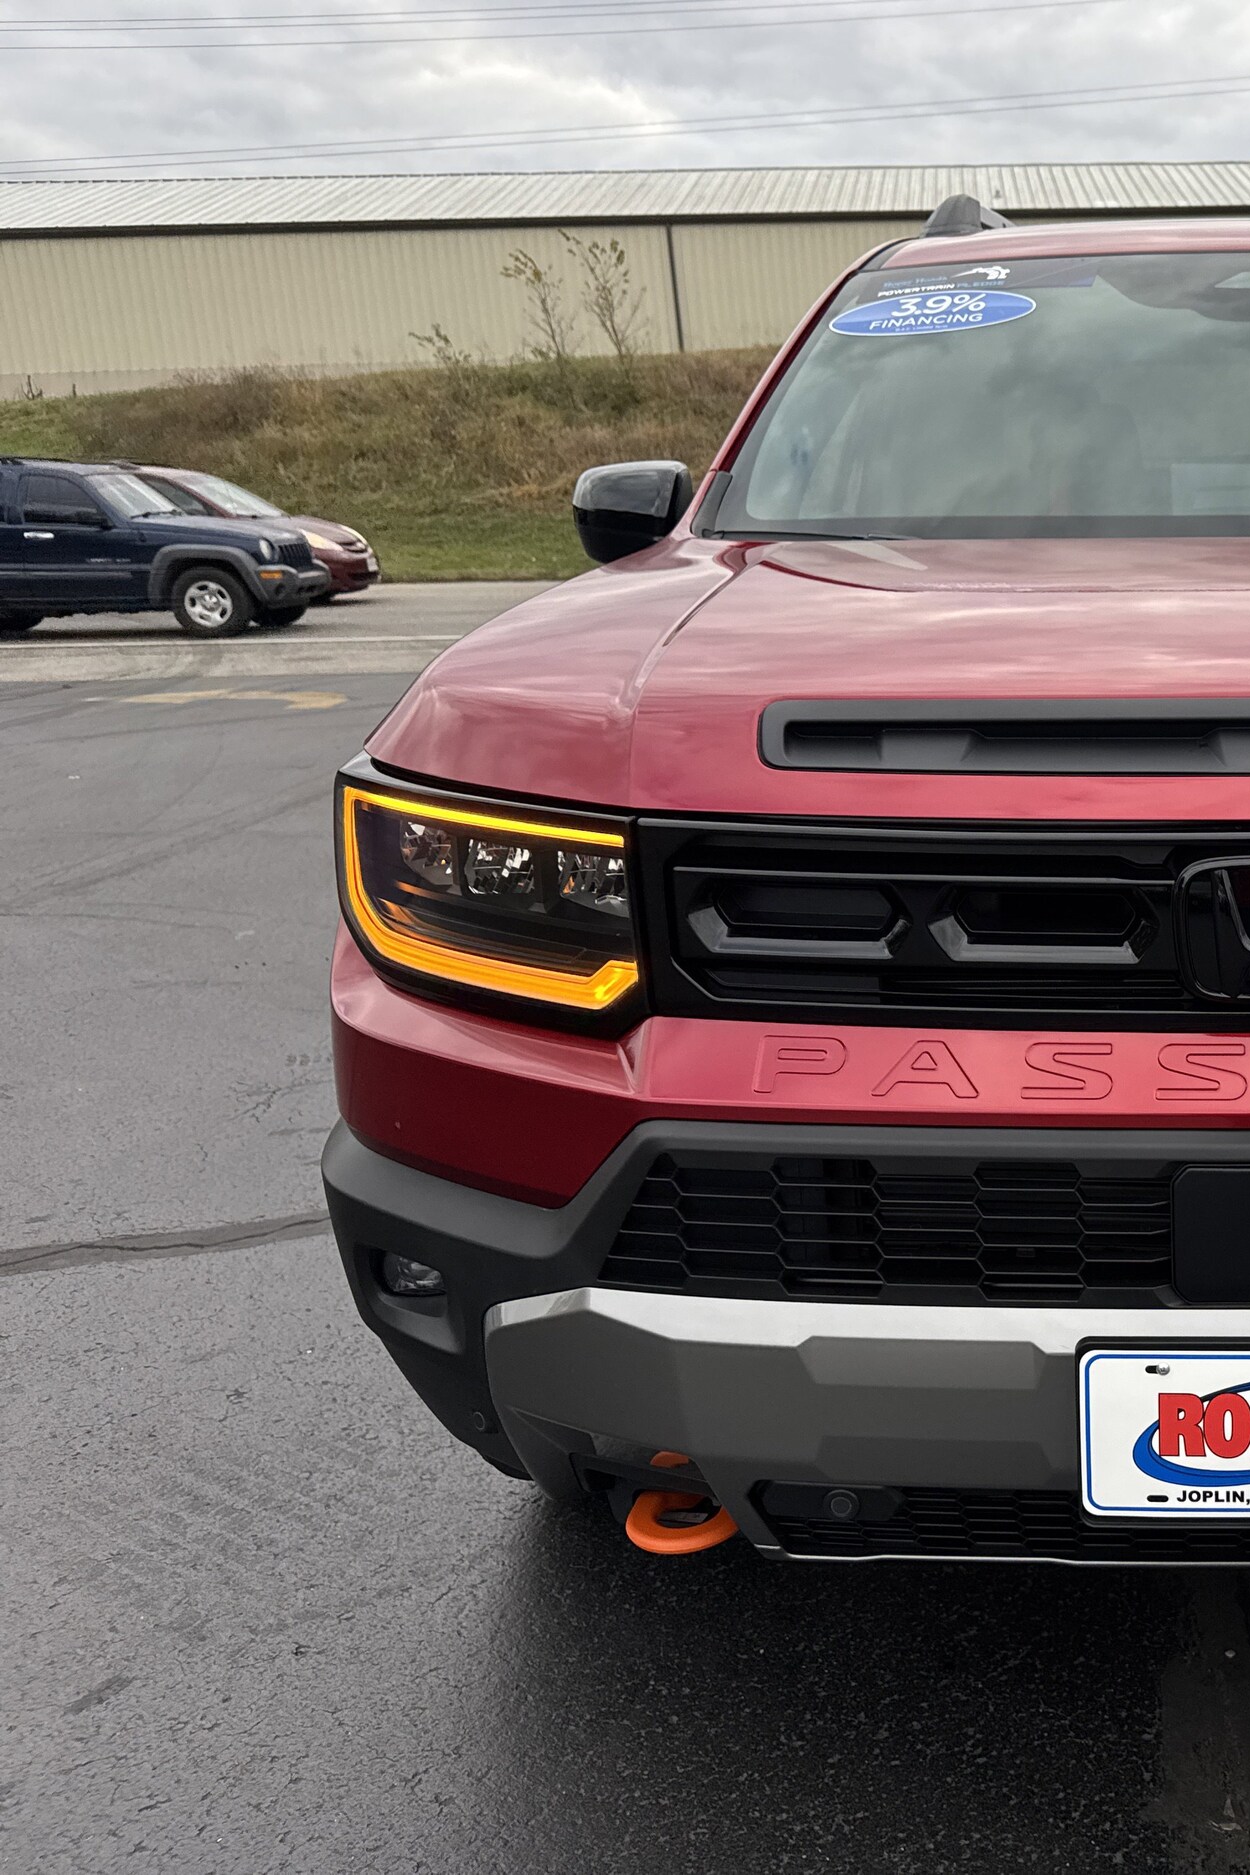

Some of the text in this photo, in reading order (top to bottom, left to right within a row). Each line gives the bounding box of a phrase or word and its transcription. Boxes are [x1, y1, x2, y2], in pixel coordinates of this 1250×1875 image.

[877, 283, 955, 298] POWERTRAIN
[890, 293, 987, 317] 3.9%
[869, 313, 983, 330] FINANCING
[1176, 1490, 1250, 1505] JOPLIN,
